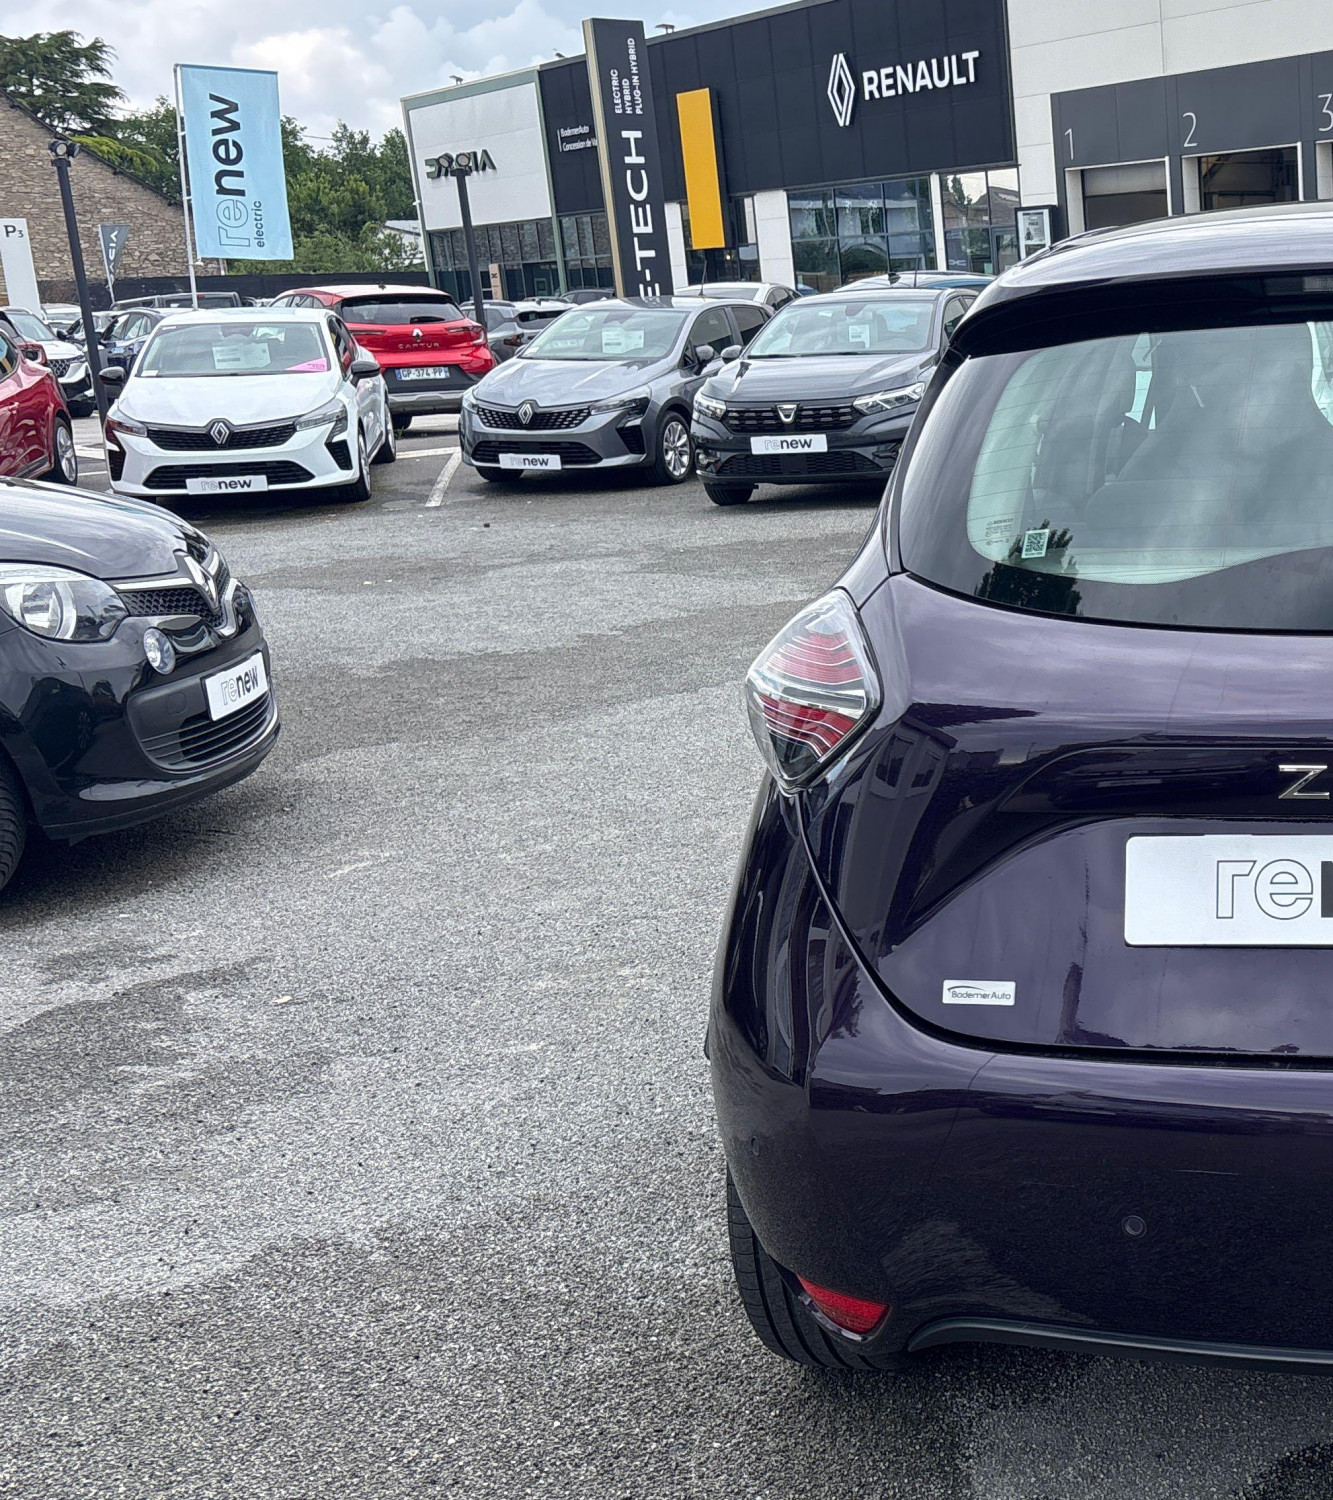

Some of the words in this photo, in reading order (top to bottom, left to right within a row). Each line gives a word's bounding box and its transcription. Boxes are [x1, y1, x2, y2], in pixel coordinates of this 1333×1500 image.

[627, 38, 639, 74] HYBRID
[610, 69, 623, 114] ELECTRIC
[862, 50, 980, 101] RENAULT
[622, 78, 633, 114] HYBRID
[632, 75, 643, 114] PLUG-IN
[1064, 127, 1075, 161] 1
[1182, 112, 1198, 148] 2
[208, 92, 251, 248] renew
[251, 200, 265, 248] electric
[397, 342, 440, 350] CAPTUR
[764, 438, 813, 451] renew
[200, 479, 252, 491] renew
[220, 665, 259, 706] renew
